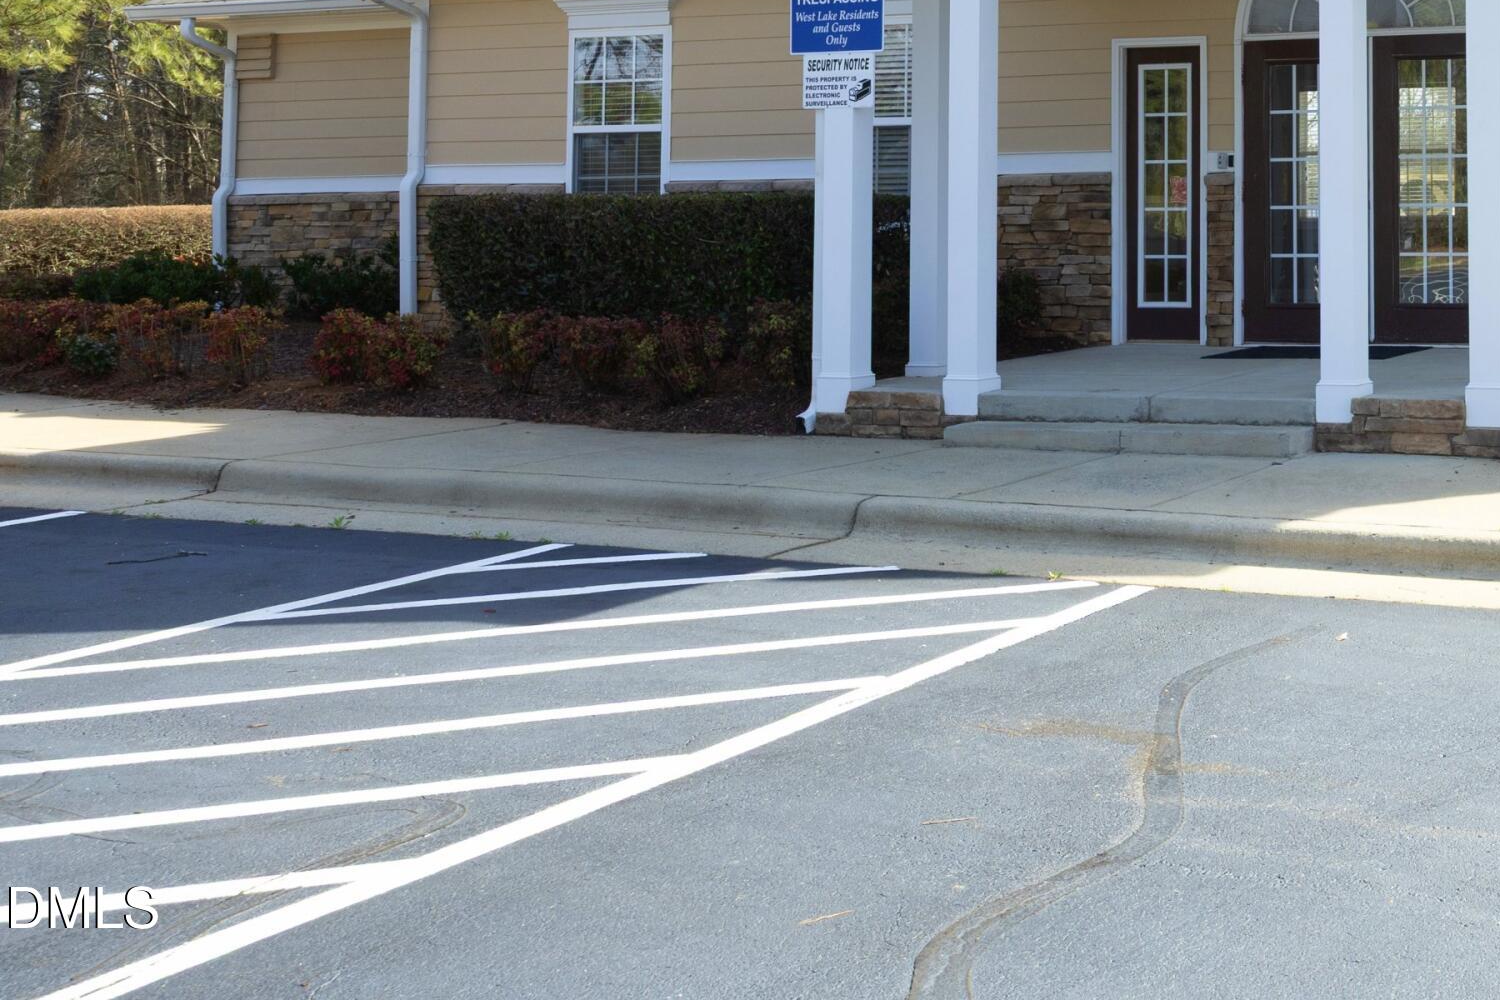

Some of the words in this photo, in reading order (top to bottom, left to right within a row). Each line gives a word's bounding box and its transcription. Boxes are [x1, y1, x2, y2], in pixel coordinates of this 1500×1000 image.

[795, 11, 816, 22] West
[817, 10, 838, 21] Lake
[839, 9, 879, 20] Residents
[812, 22, 829, 34] and
[831, 22, 860, 32] Guests
[825, 34, 848, 48] Only
[807, 59, 842, 72] SECURITY
[843, 58, 870, 70] NOTICE
